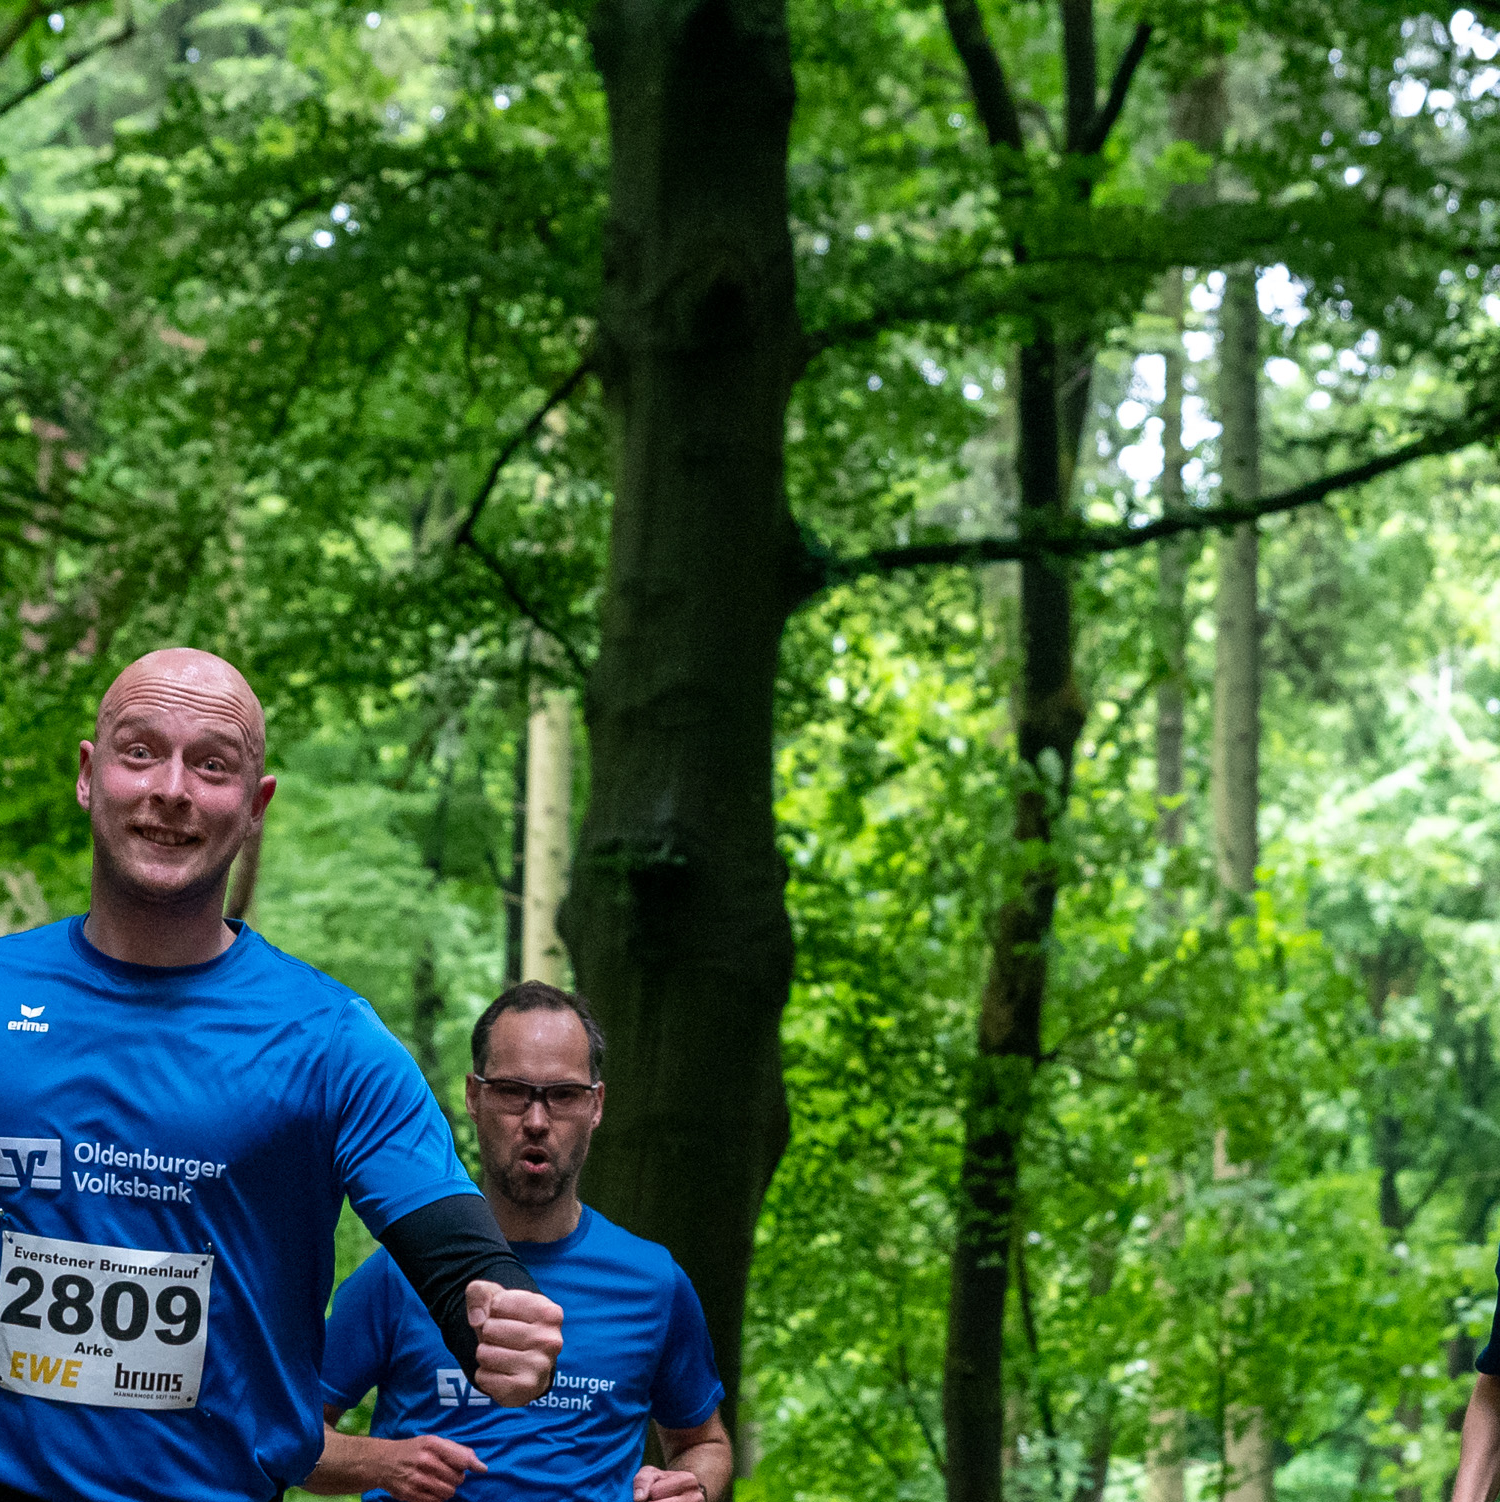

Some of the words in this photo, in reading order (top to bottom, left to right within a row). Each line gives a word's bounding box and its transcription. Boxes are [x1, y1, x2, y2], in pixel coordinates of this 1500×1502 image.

[7, 1018, 49, 1033] erima
[73, 1142, 227, 1181] Oldenburger
[72, 1171, 192, 1204] Volksbank
[14, 1246, 95, 1269] Everstener
[100, 1259, 200, 1280] Brunnenlauf
[0, 1265, 202, 1346] 2809
[74, 1341, 113, 1358] Arke
[9, 1350, 83, 1389] EWE
[114, 1362, 184, 1393] bruns
[552, 1371, 616, 1394] burger
[529, 1391, 593, 1411] sbank
